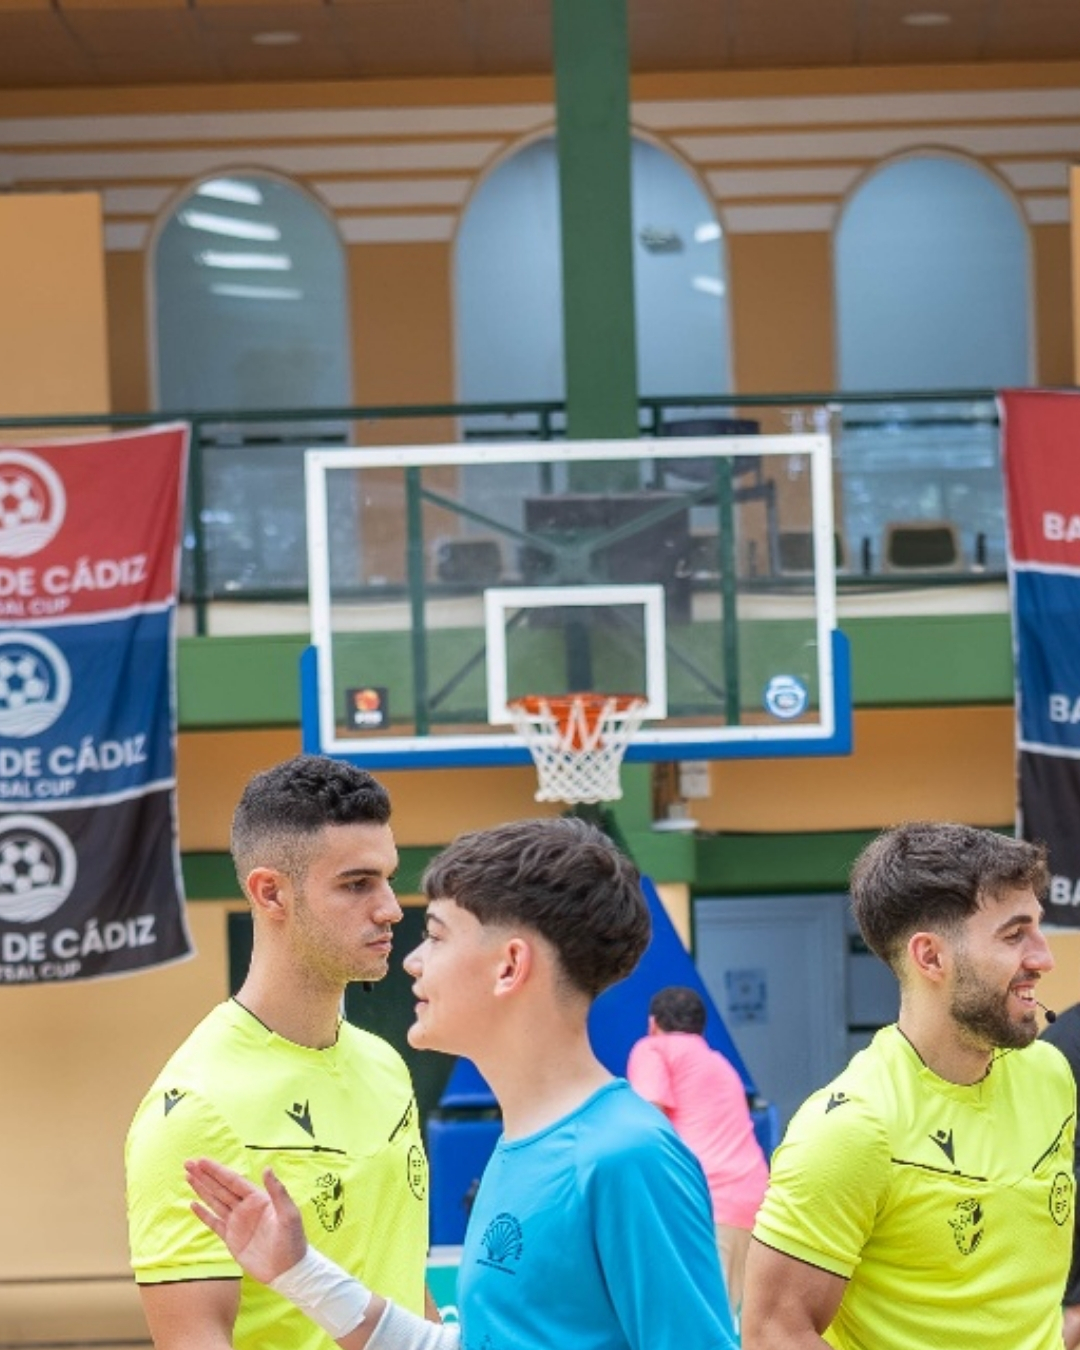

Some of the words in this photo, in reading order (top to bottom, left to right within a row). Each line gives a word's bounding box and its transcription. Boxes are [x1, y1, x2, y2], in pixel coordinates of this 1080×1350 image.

[41, 554, 148, 593] CÁDIZ
[27, 595, 71, 616] CUP
[47, 733, 148, 774] CÁDIZ
[34, 777, 76, 797] CUP
[1, 931, 48, 963] DE
[52, 914, 158, 956] CÁDIZ
[39, 959, 82, 979] CUP
